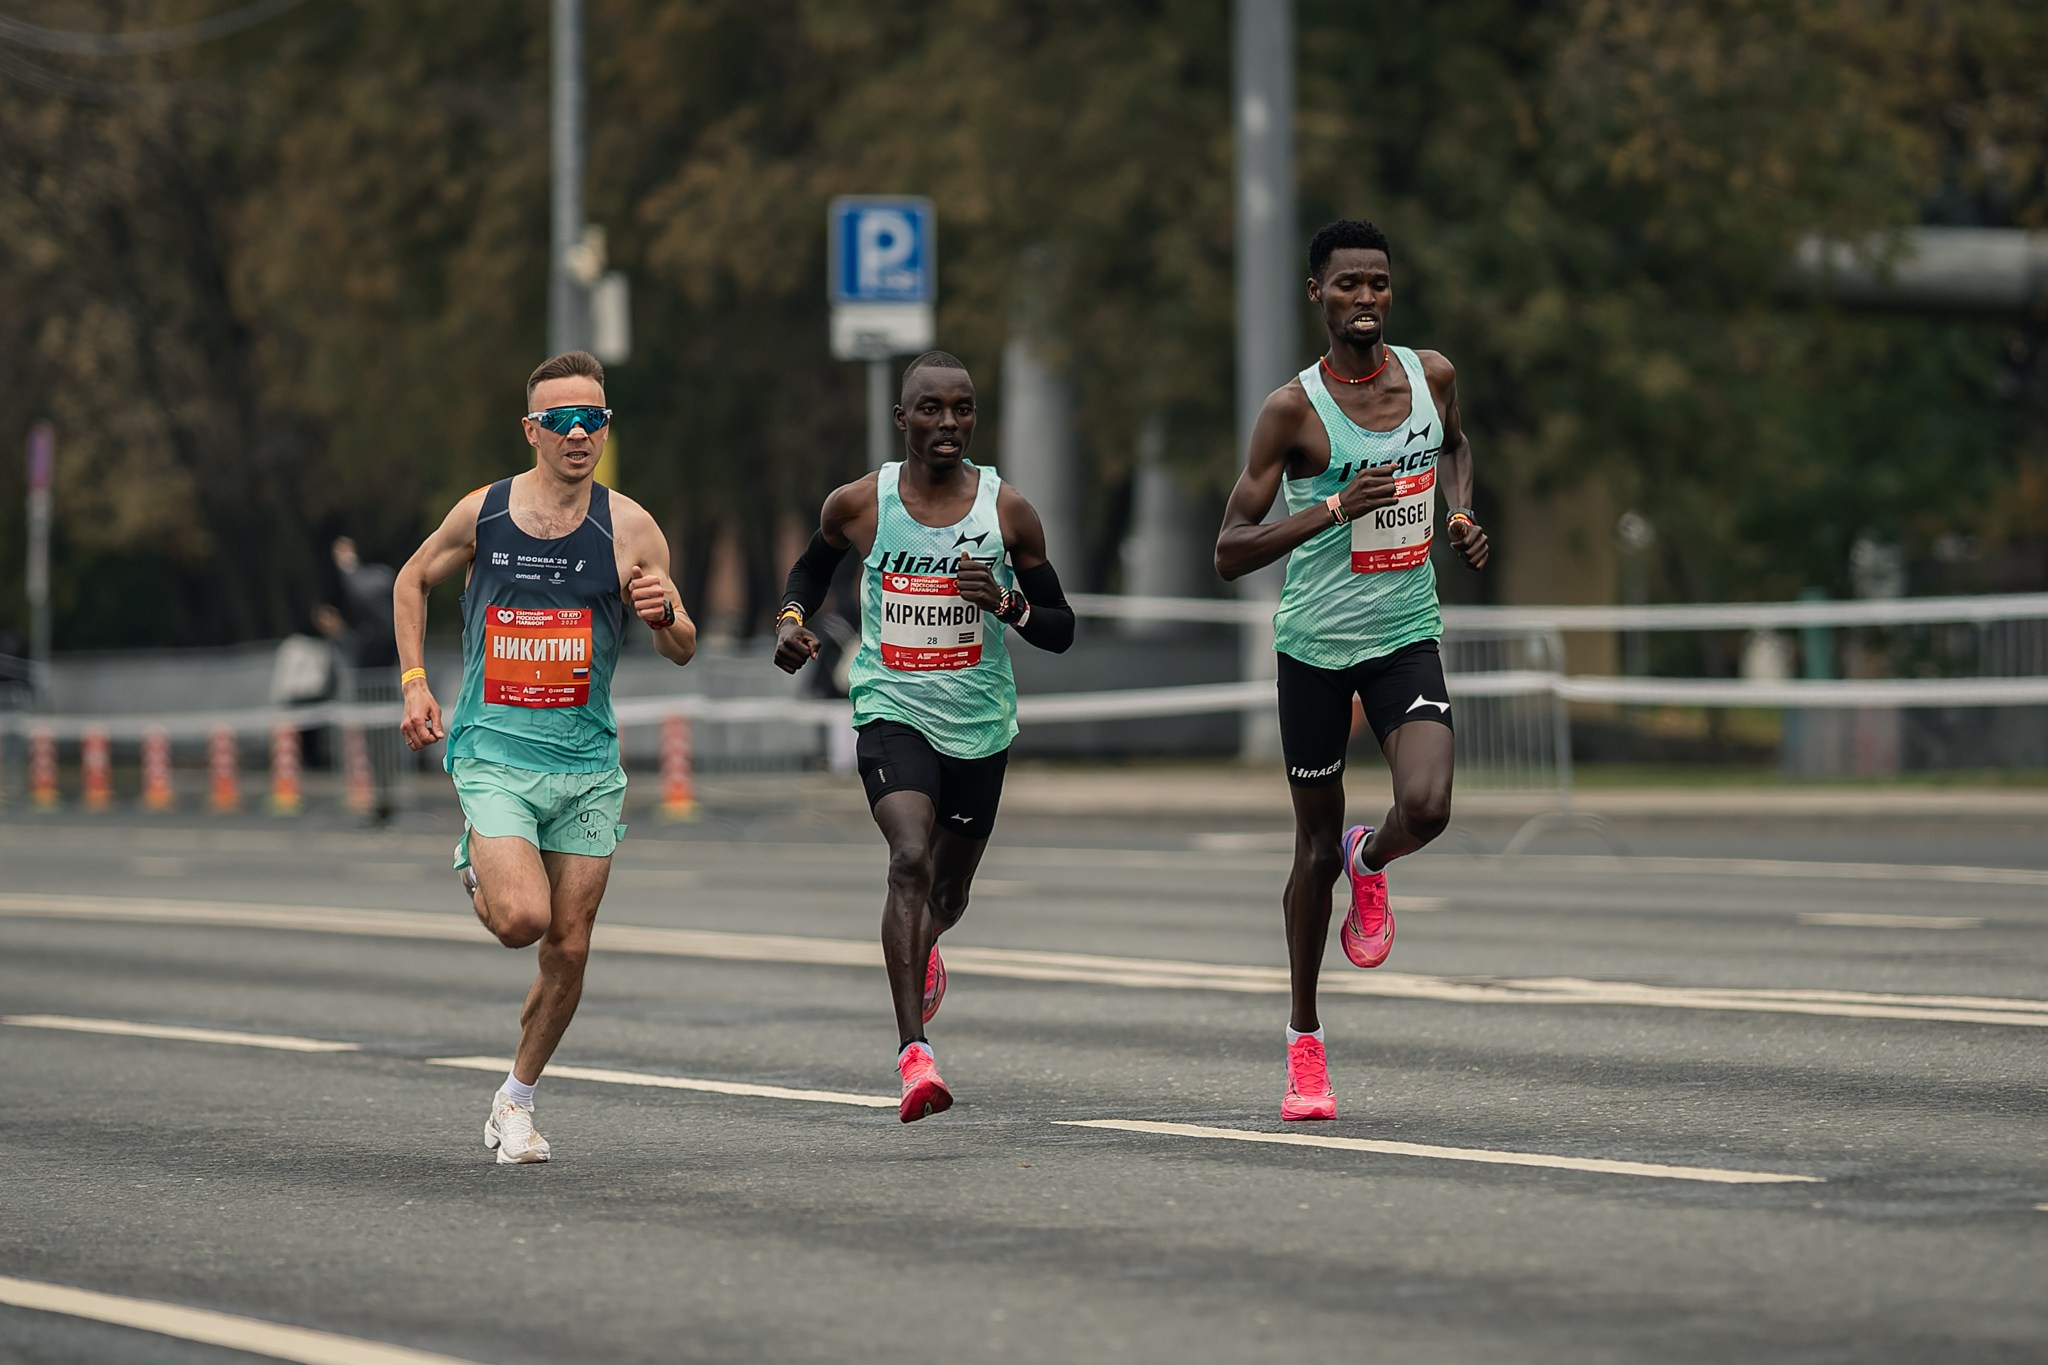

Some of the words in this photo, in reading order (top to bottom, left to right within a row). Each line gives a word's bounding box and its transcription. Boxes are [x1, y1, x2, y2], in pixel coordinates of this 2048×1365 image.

[858, 209, 914, 289] P
[1375, 501, 1427, 530] KOSGEI
[1401, 536, 1406, 544] 2
[885, 602, 980, 626] KIPKEMBOI
[493, 635, 585, 661] НИКИТИН
[926, 636, 938, 645] 28
[535, 670, 541, 680] 1
[1291, 759, 1341, 778] HIRACER
[579, 812, 590, 823] U
[586, 830, 597, 839] M
